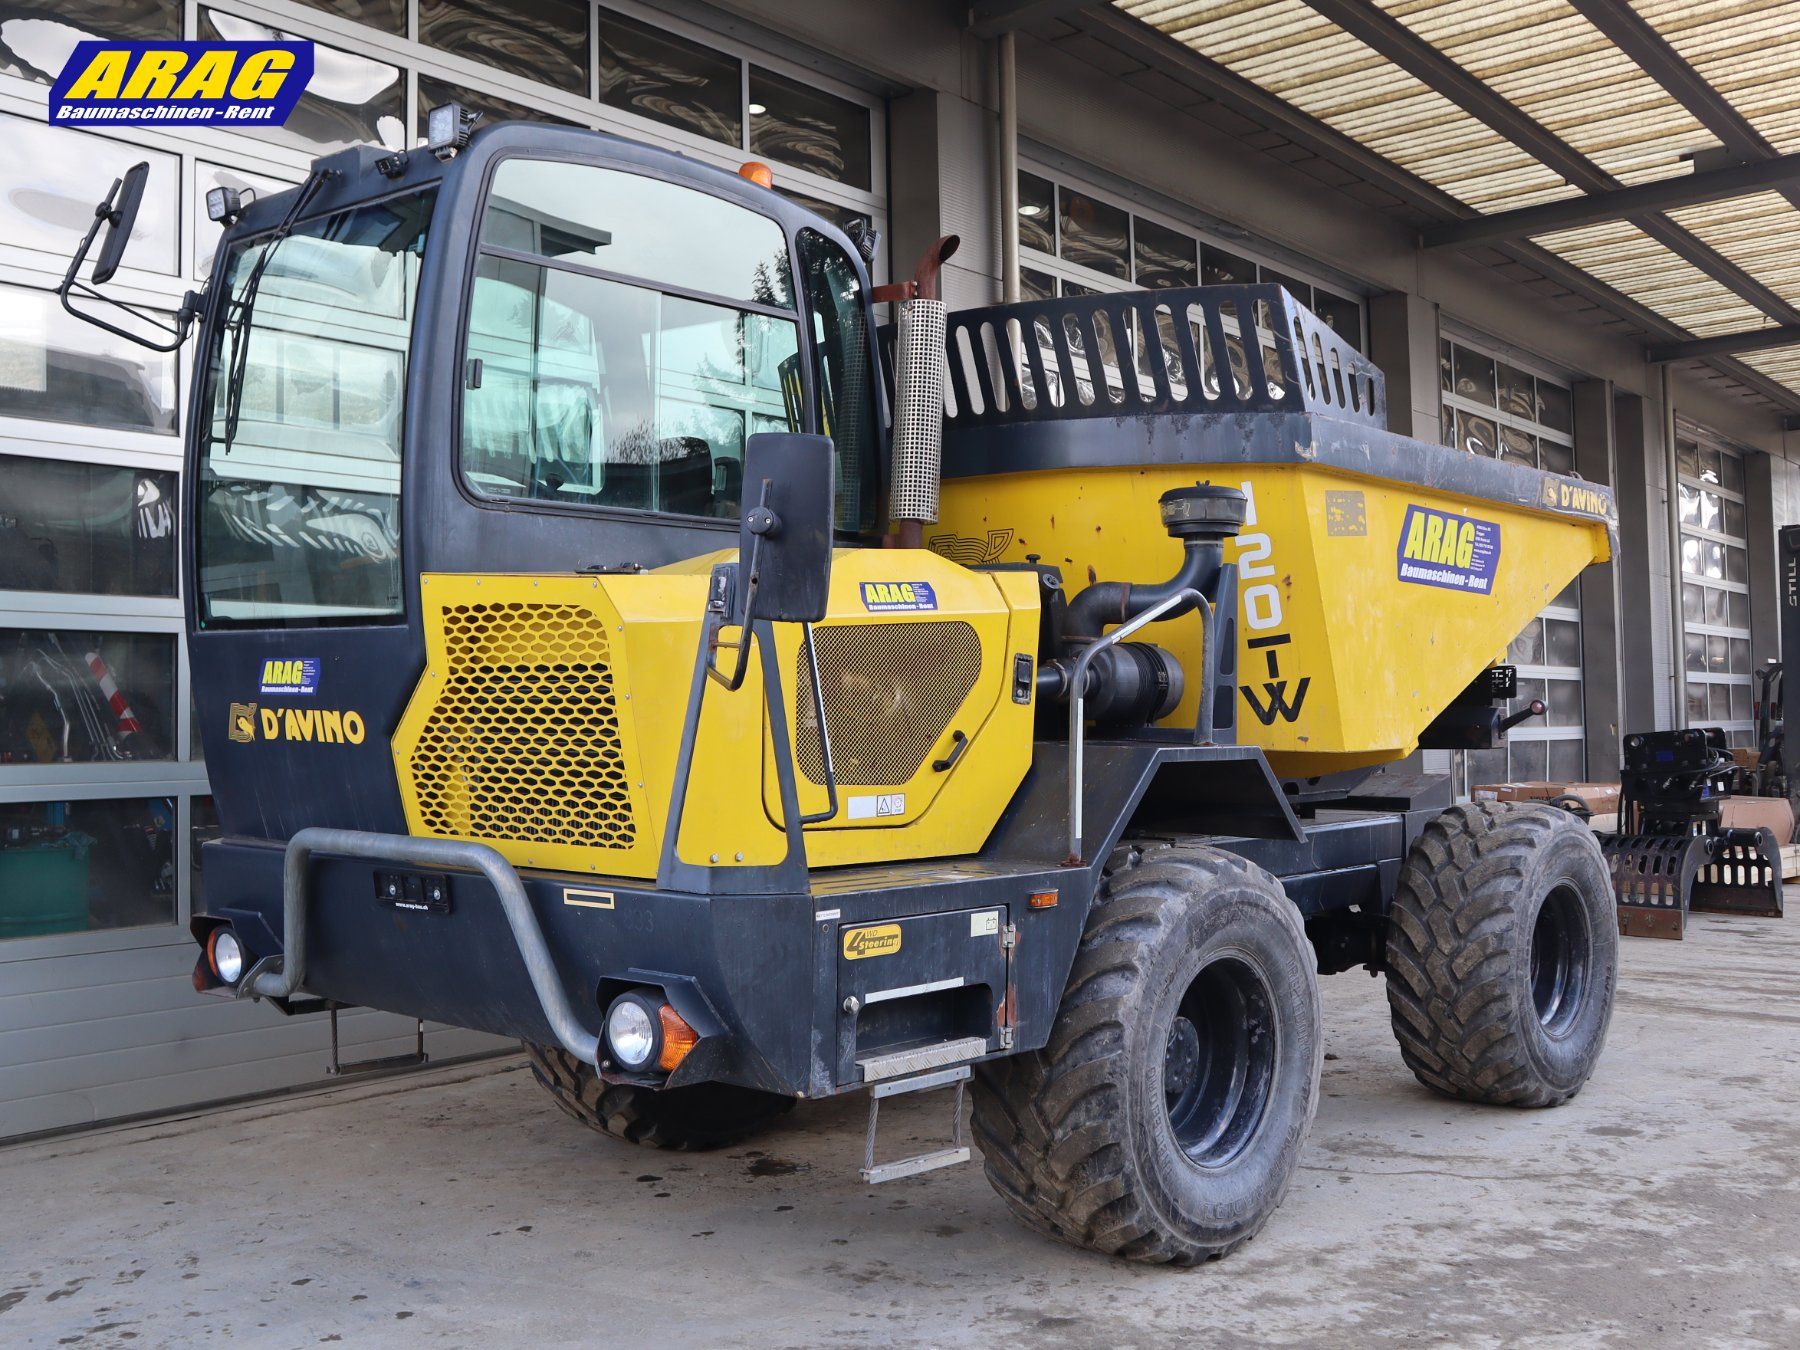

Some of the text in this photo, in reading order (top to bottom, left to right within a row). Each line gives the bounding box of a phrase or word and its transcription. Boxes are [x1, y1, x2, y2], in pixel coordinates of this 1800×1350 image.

[1404, 511, 1475, 568] ARAG
[865, 583, 916, 603] ARAG
[1788, 557, 1798, 606] STILL
[262, 661, 303, 684] ARAG
[858, 936, 899, 950] Steering
